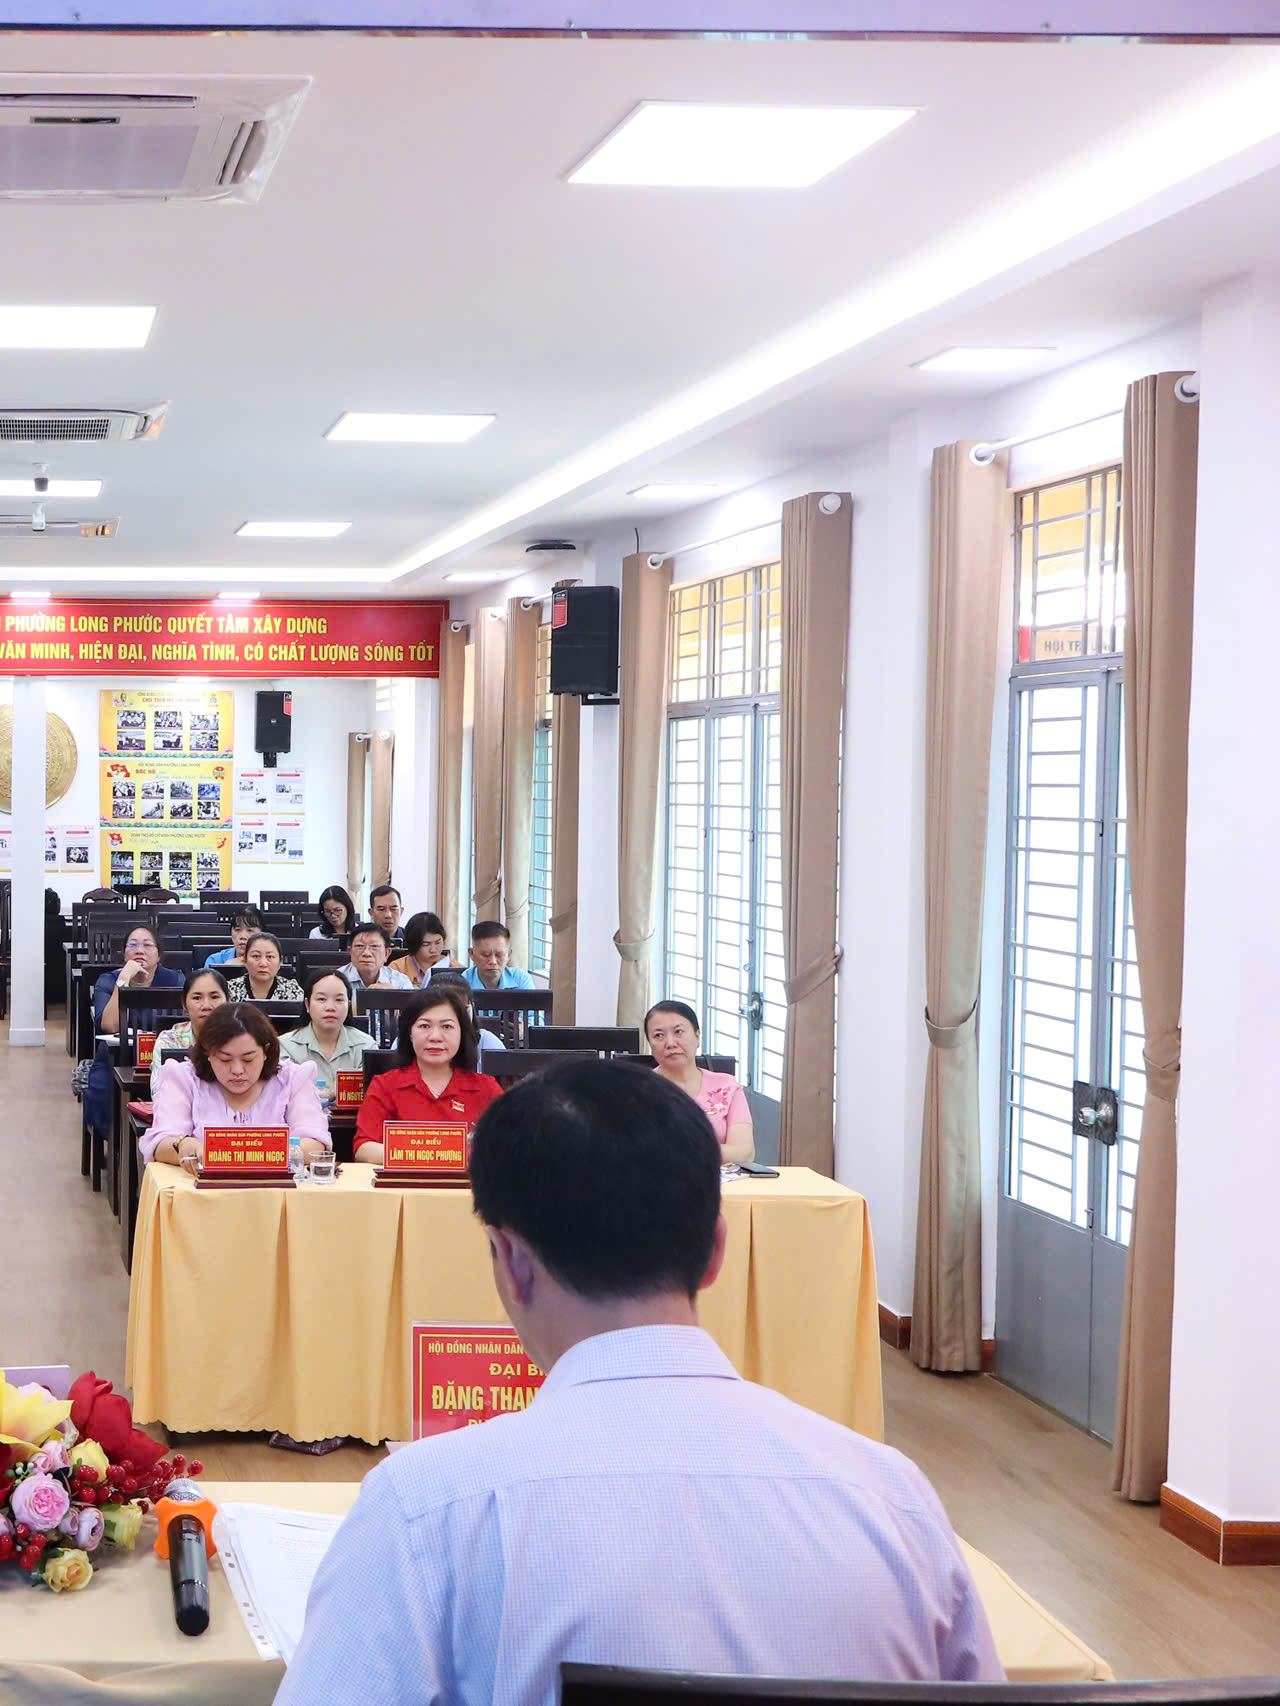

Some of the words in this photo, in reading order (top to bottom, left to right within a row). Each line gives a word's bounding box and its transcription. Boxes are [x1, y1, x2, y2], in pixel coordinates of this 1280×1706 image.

[5, 611, 66, 632] PHƯỜNG
[71, 616, 109, 633] LONG
[113, 613, 163, 633] PHƯỚC
[167, 612, 213, 634] QUYẾT
[217, 614, 249, 634] TÂM
[253, 614, 283, 634] XÂY
[287, 616, 328, 638] DỰNG
[30, 643, 74, 661] MINH,
[79, 640, 113, 663] HIỆN
[118, 643, 147, 663] ĐẠI,
[151, 641, 197, 661] NGHĨA
[201, 641, 239, 662] TÌNH,
[244, 641, 264, 661] CÓ
[269, 639, 307, 661] CHẤT
[311, 643, 359, 664] LƯỢNG
[364, 640, 404, 661] SỐNG
[408, 640, 435, 661] TỐT
[234, 1151, 244, 1164] THỊ
[246, 1151, 264, 1162] MINH
[266, 1151, 284, 1164] NGỌC
[405, 1150, 415, 1163] THỊ
[417, 1150, 434, 1163] NGỌC
[428, 1341, 444, 1355] HỘI
[447, 1340, 472, 1354] ĐỒNG
[475, 1341, 501, 1354] NHÂN
[504, 1341, 524, 1355] DÂN
[489, 1363, 521, 1379] ĐẠI
[527, 1363, 547, 1376] BI
[432, 1380, 484, 1415] ĐẶNG
